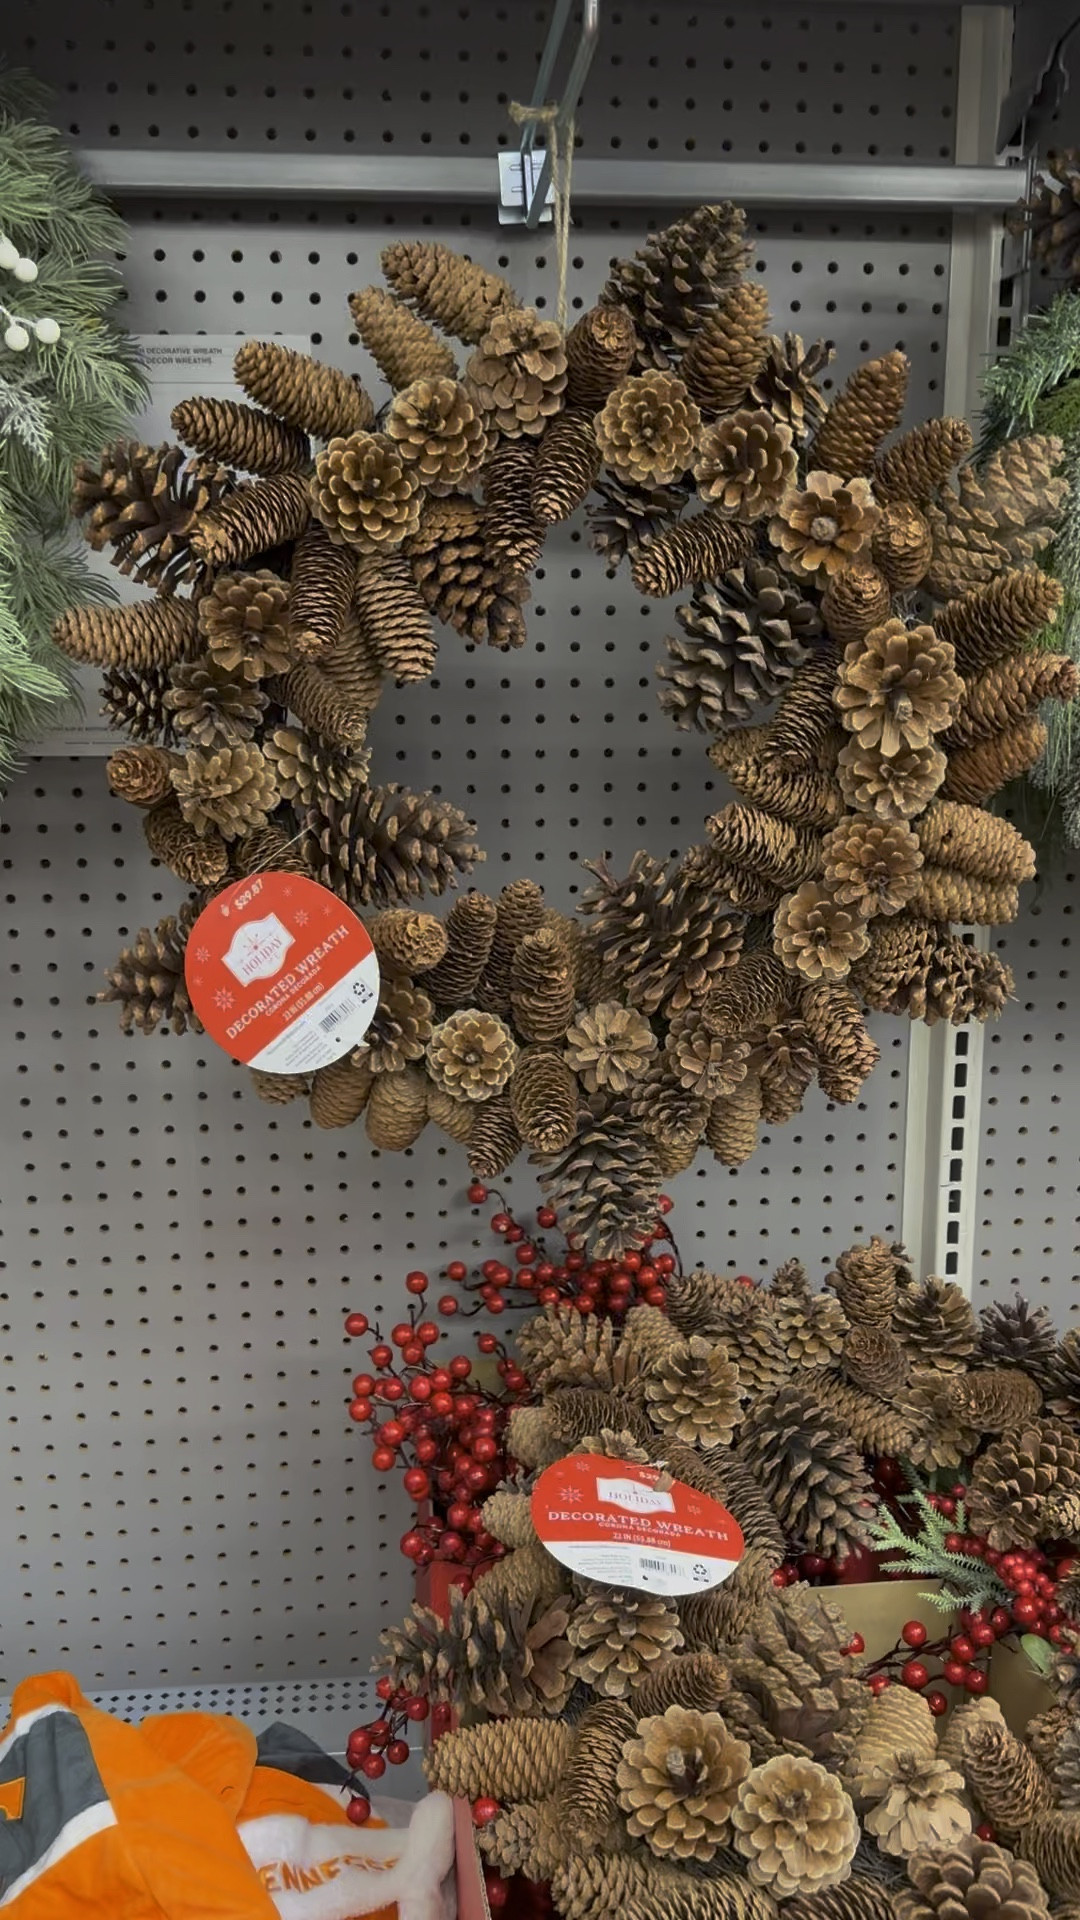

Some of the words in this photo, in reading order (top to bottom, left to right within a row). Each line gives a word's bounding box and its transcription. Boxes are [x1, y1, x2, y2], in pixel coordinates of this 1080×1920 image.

[146, 347, 191, 355] DECORATIVE
[192, 347, 223, 355] WREATH
[146, 356, 174, 364] DECOR
[234, 878, 264, 910] $29.87
[242, 936, 283, 976] HOLIDAY
[226, 973, 296, 1039] DECORATED
[294, 924, 350, 975] WREATH
[609, 1491, 661, 1505] HOLIDAY
[548, 1511, 651, 1527] DECORATED
[656, 1519, 729, 1541] WREATH
[598, 1521, 634, 1531] CORONA
[636, 1525, 681, 1538] DECORADA
